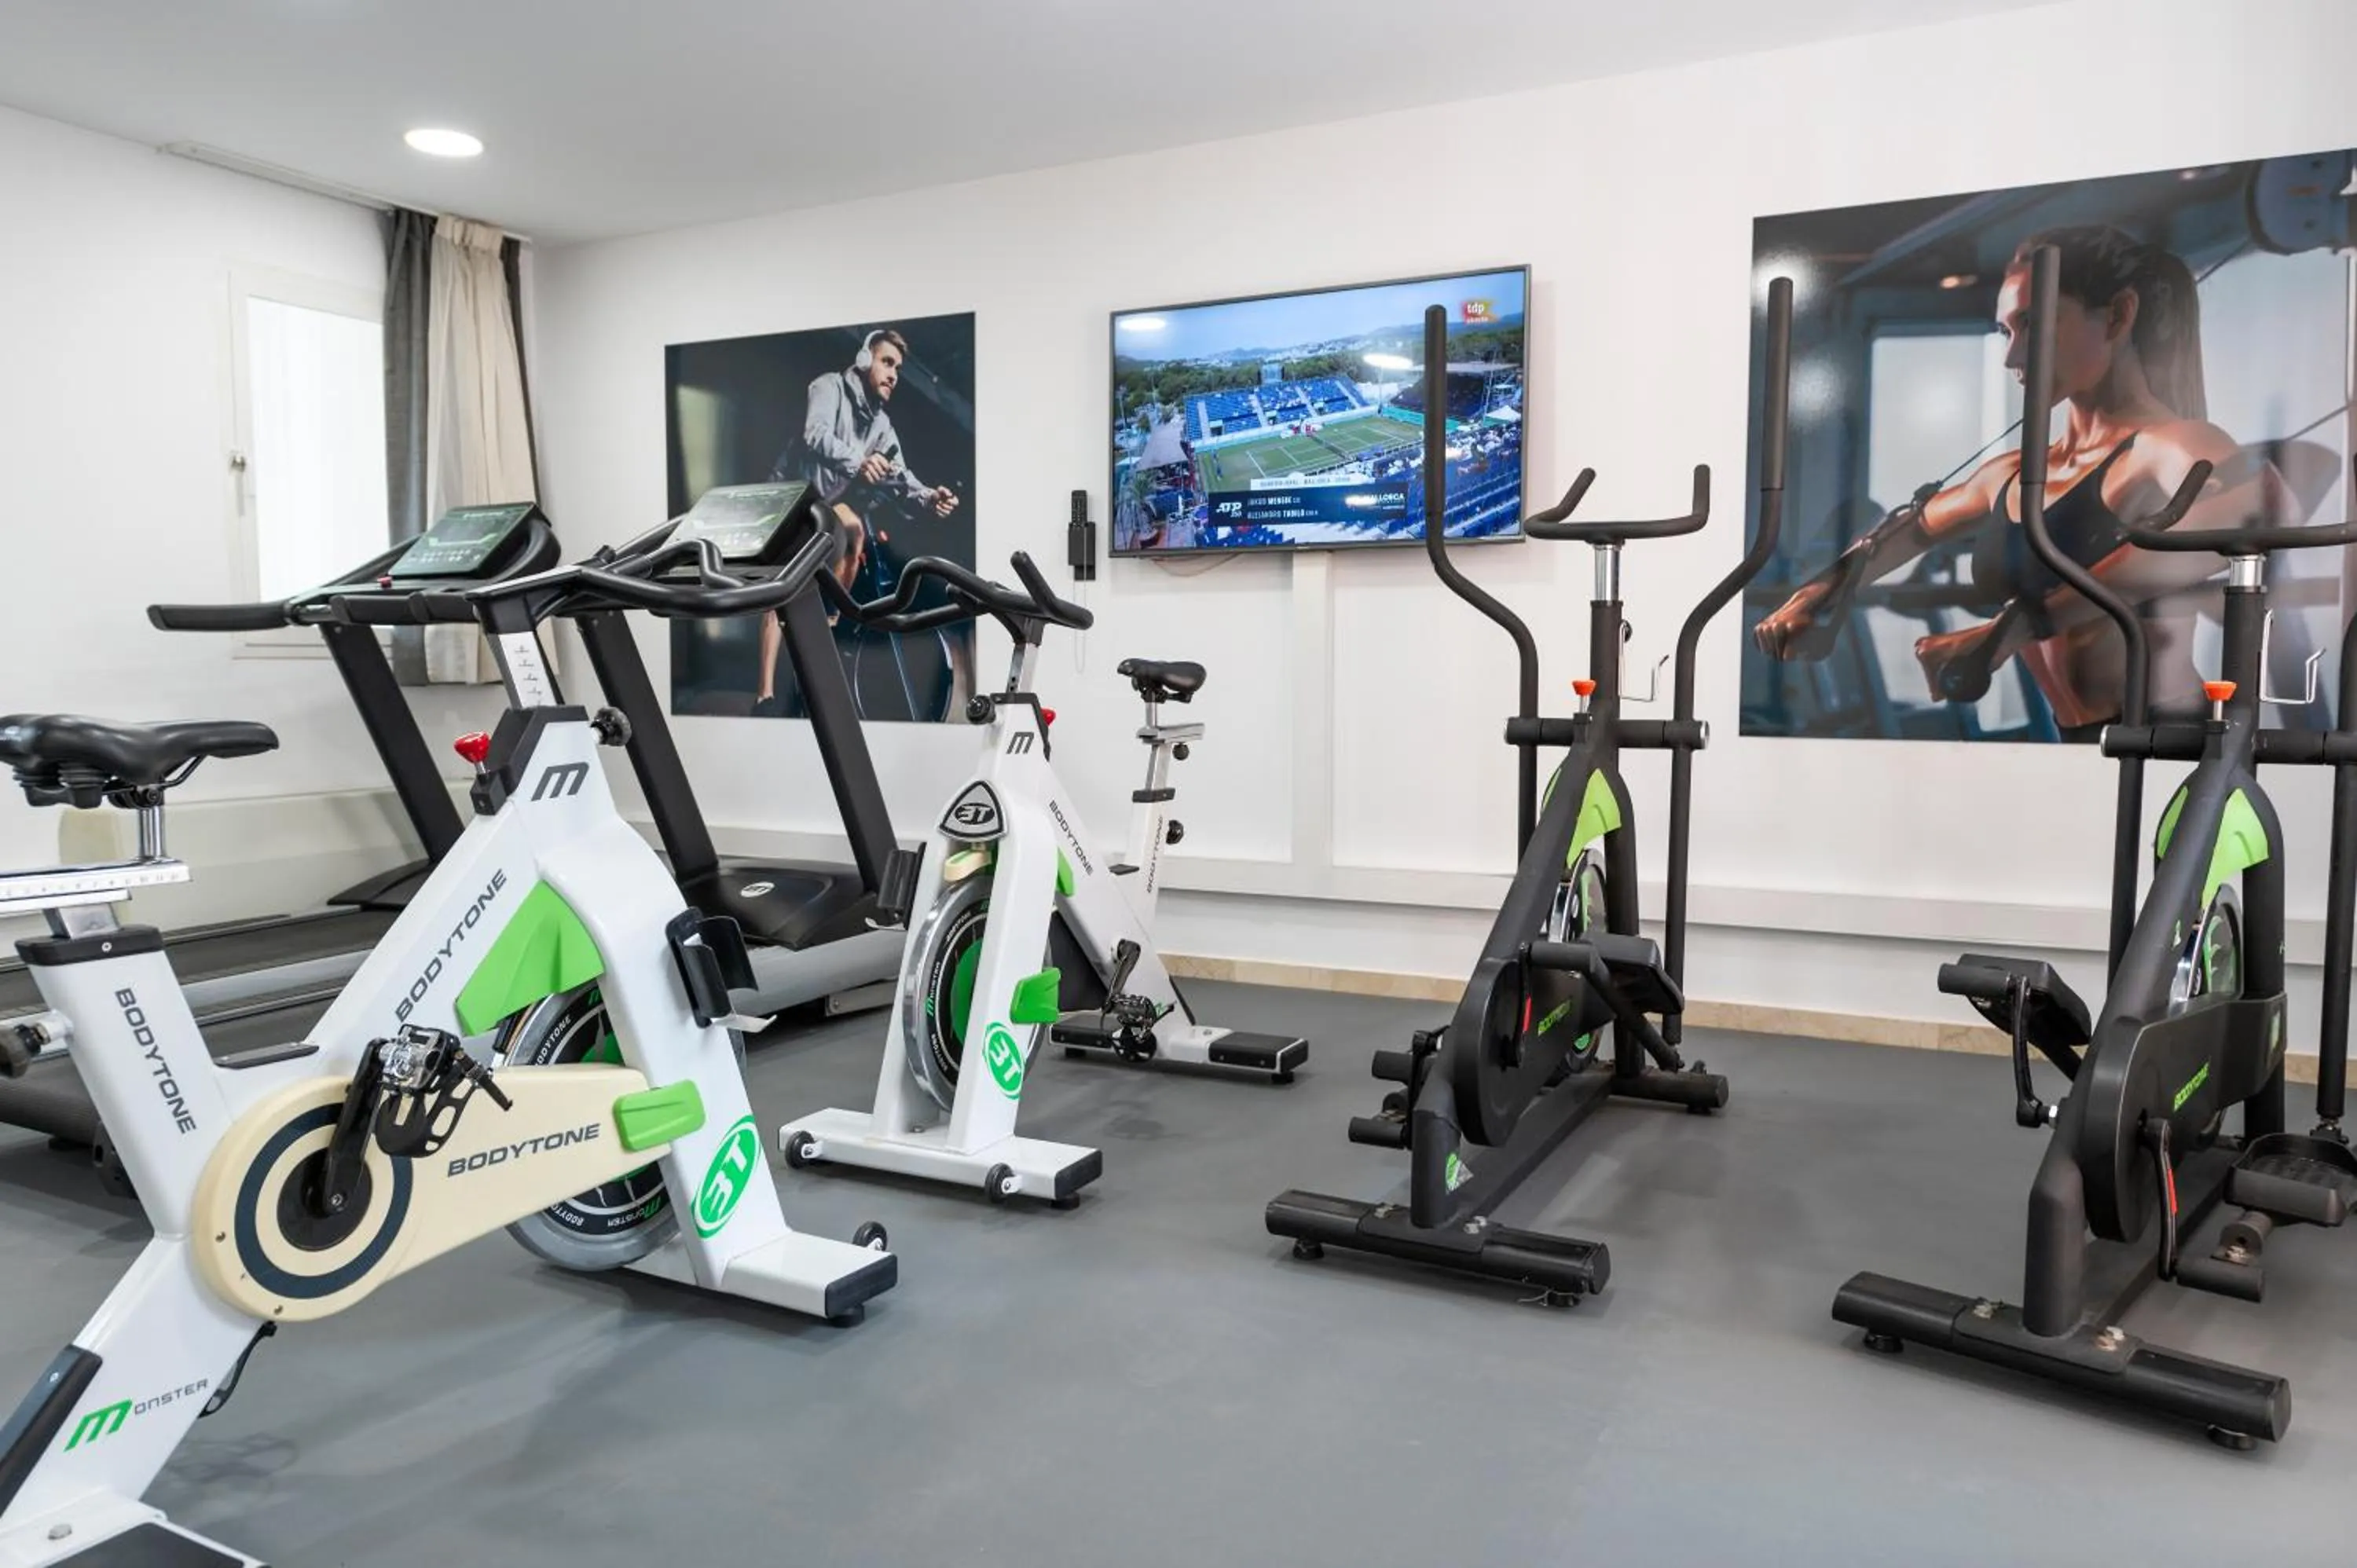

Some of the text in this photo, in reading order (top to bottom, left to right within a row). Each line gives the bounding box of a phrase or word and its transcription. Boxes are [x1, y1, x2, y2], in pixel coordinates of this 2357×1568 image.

[1467, 302, 1484, 314] tdp
[1049, 800, 1094, 876] BODYTONE
[394, 868, 508, 1023] BODYTONE
[115, 987, 197, 1134] BODYTONE
[535, 1013, 572, 1066] ODYTONE
[447, 1123, 601, 1178] BODYTONE
